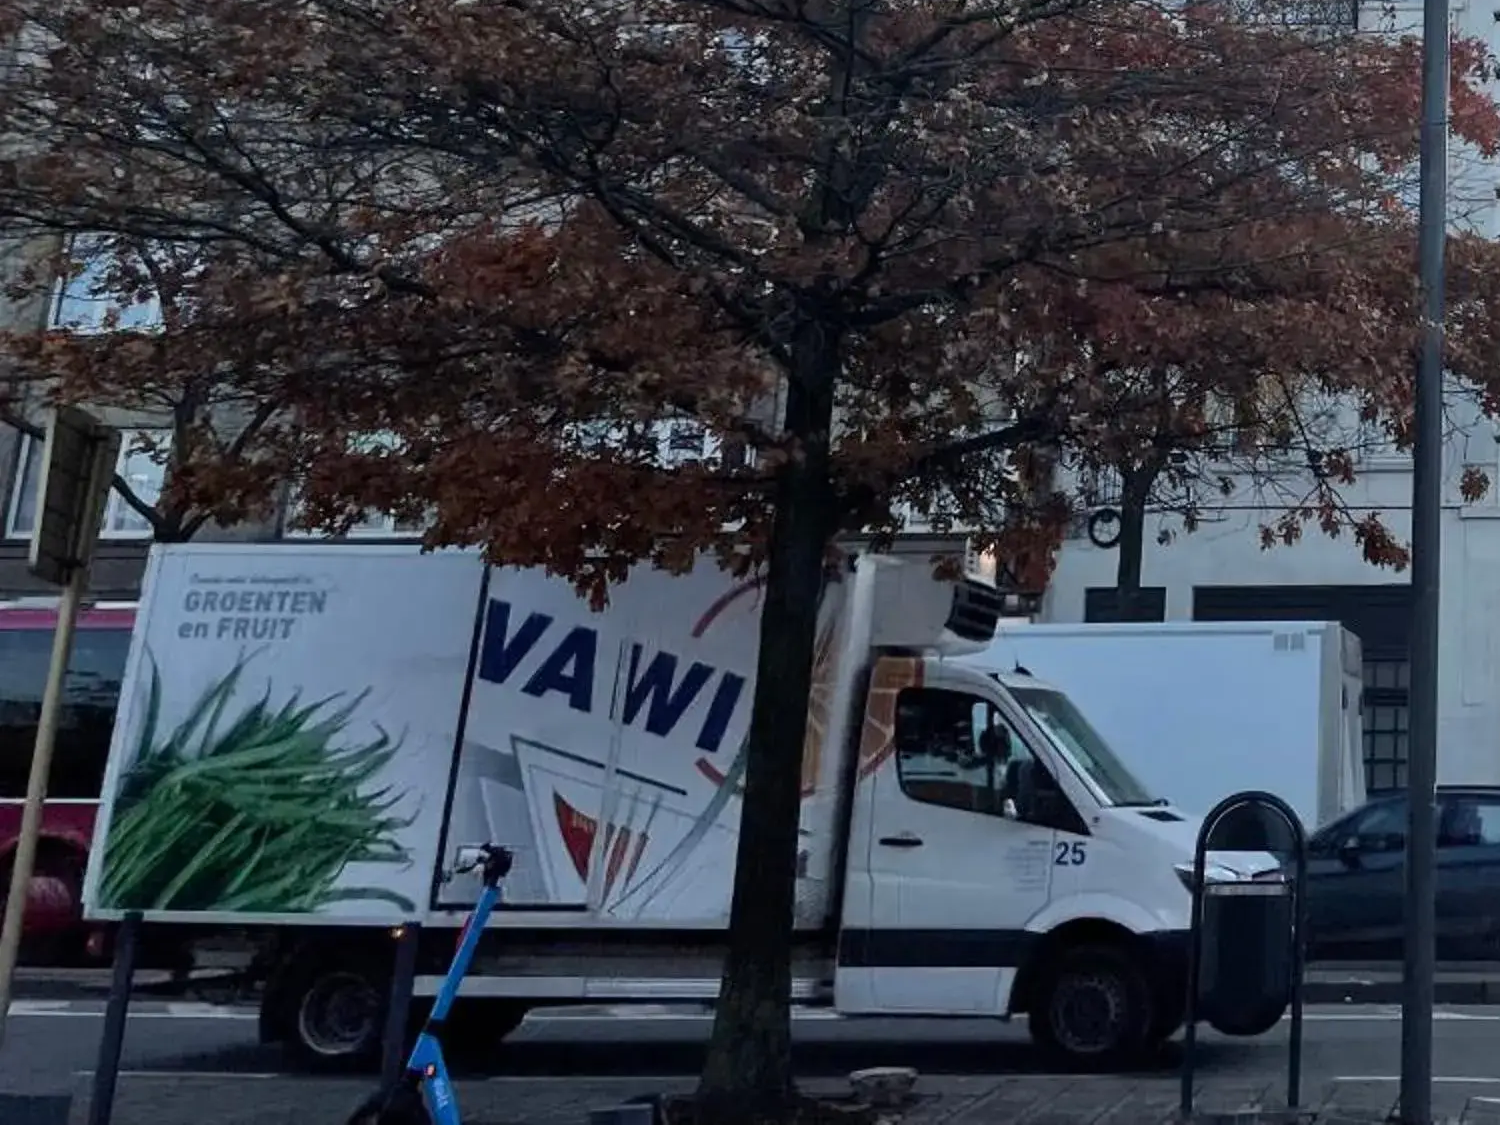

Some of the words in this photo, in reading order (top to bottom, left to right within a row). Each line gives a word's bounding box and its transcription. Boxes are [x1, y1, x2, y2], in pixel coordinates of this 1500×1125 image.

[184, 589, 328, 614] GROENTEN
[177, 621, 210, 639] en
[216, 616, 295, 640] FRUIT
[479, 597, 747, 753] VAWI
[1055, 841, 1087, 866] 25
